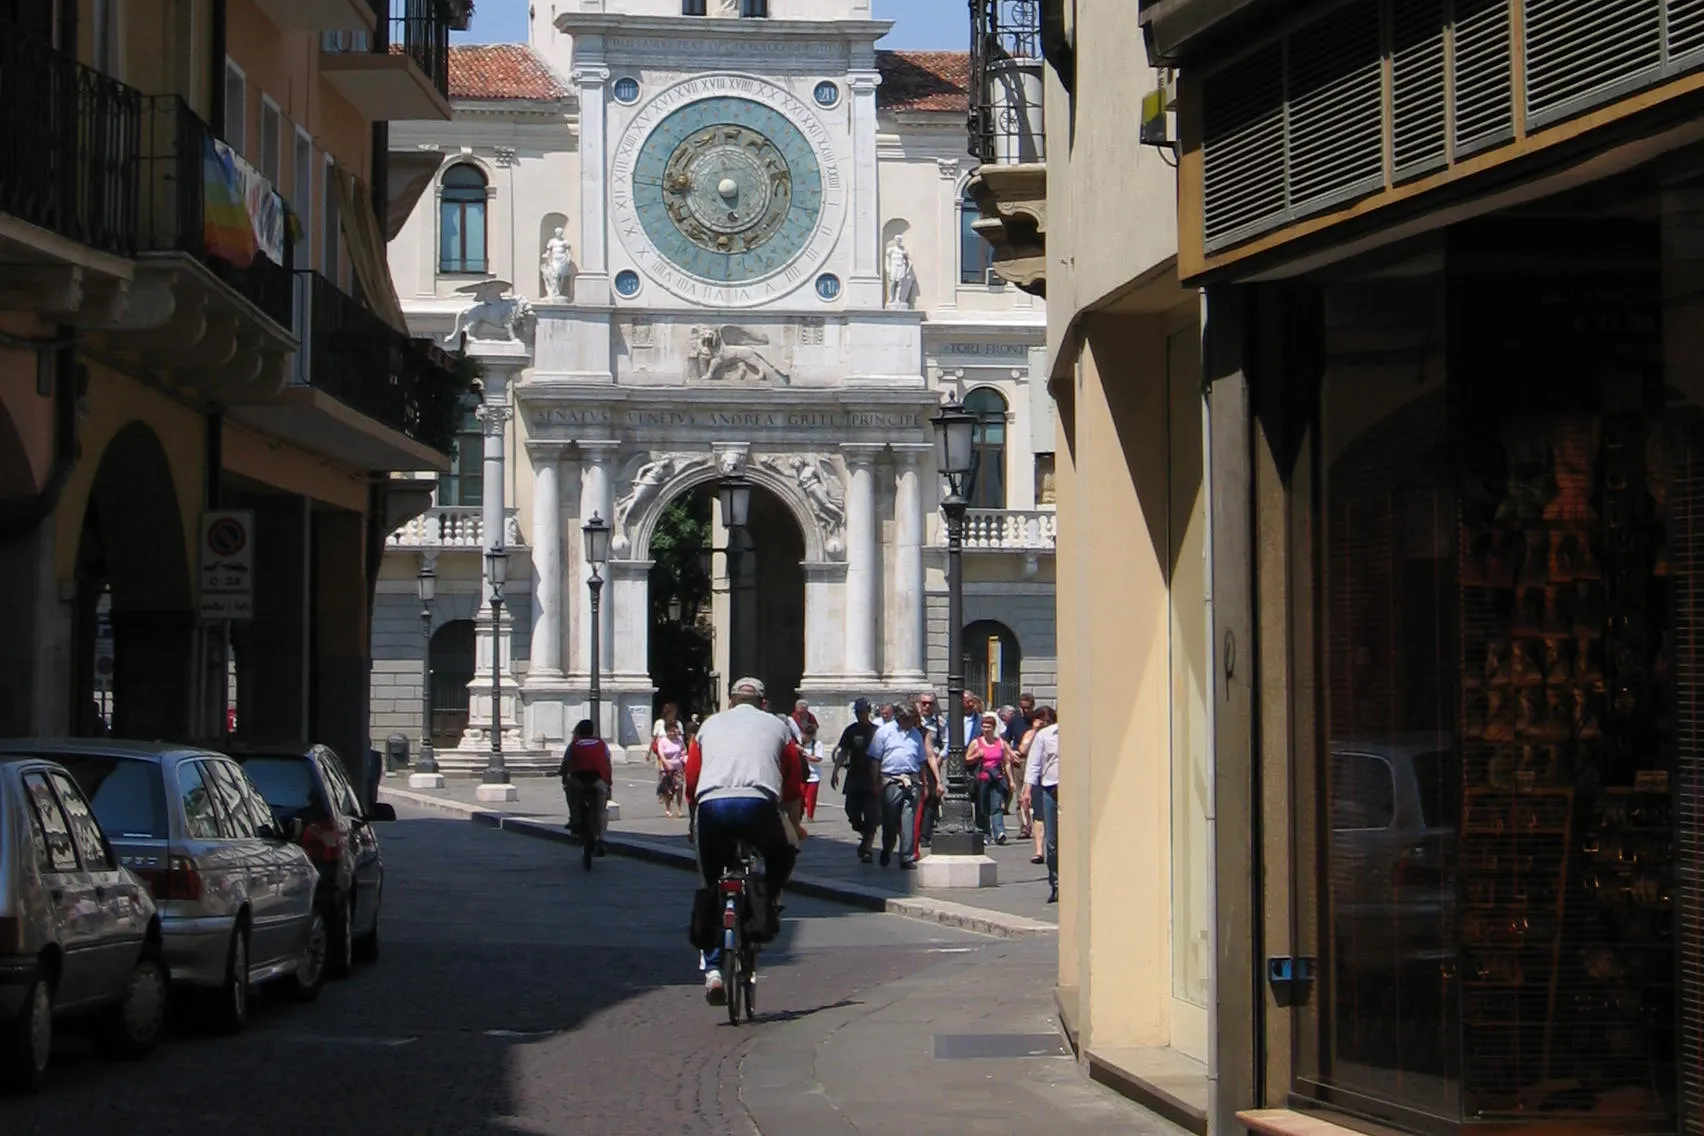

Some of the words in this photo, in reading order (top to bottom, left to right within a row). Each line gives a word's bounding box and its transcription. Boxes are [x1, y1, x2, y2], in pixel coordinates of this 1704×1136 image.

[756, 82, 780, 101] XX
[651, 94, 674, 113] XVI
[631, 112, 651, 133] XV
[614, 190, 628, 210] XII
[636, 246, 650, 259] X
[850, 414, 922, 426] PRINCIPE
